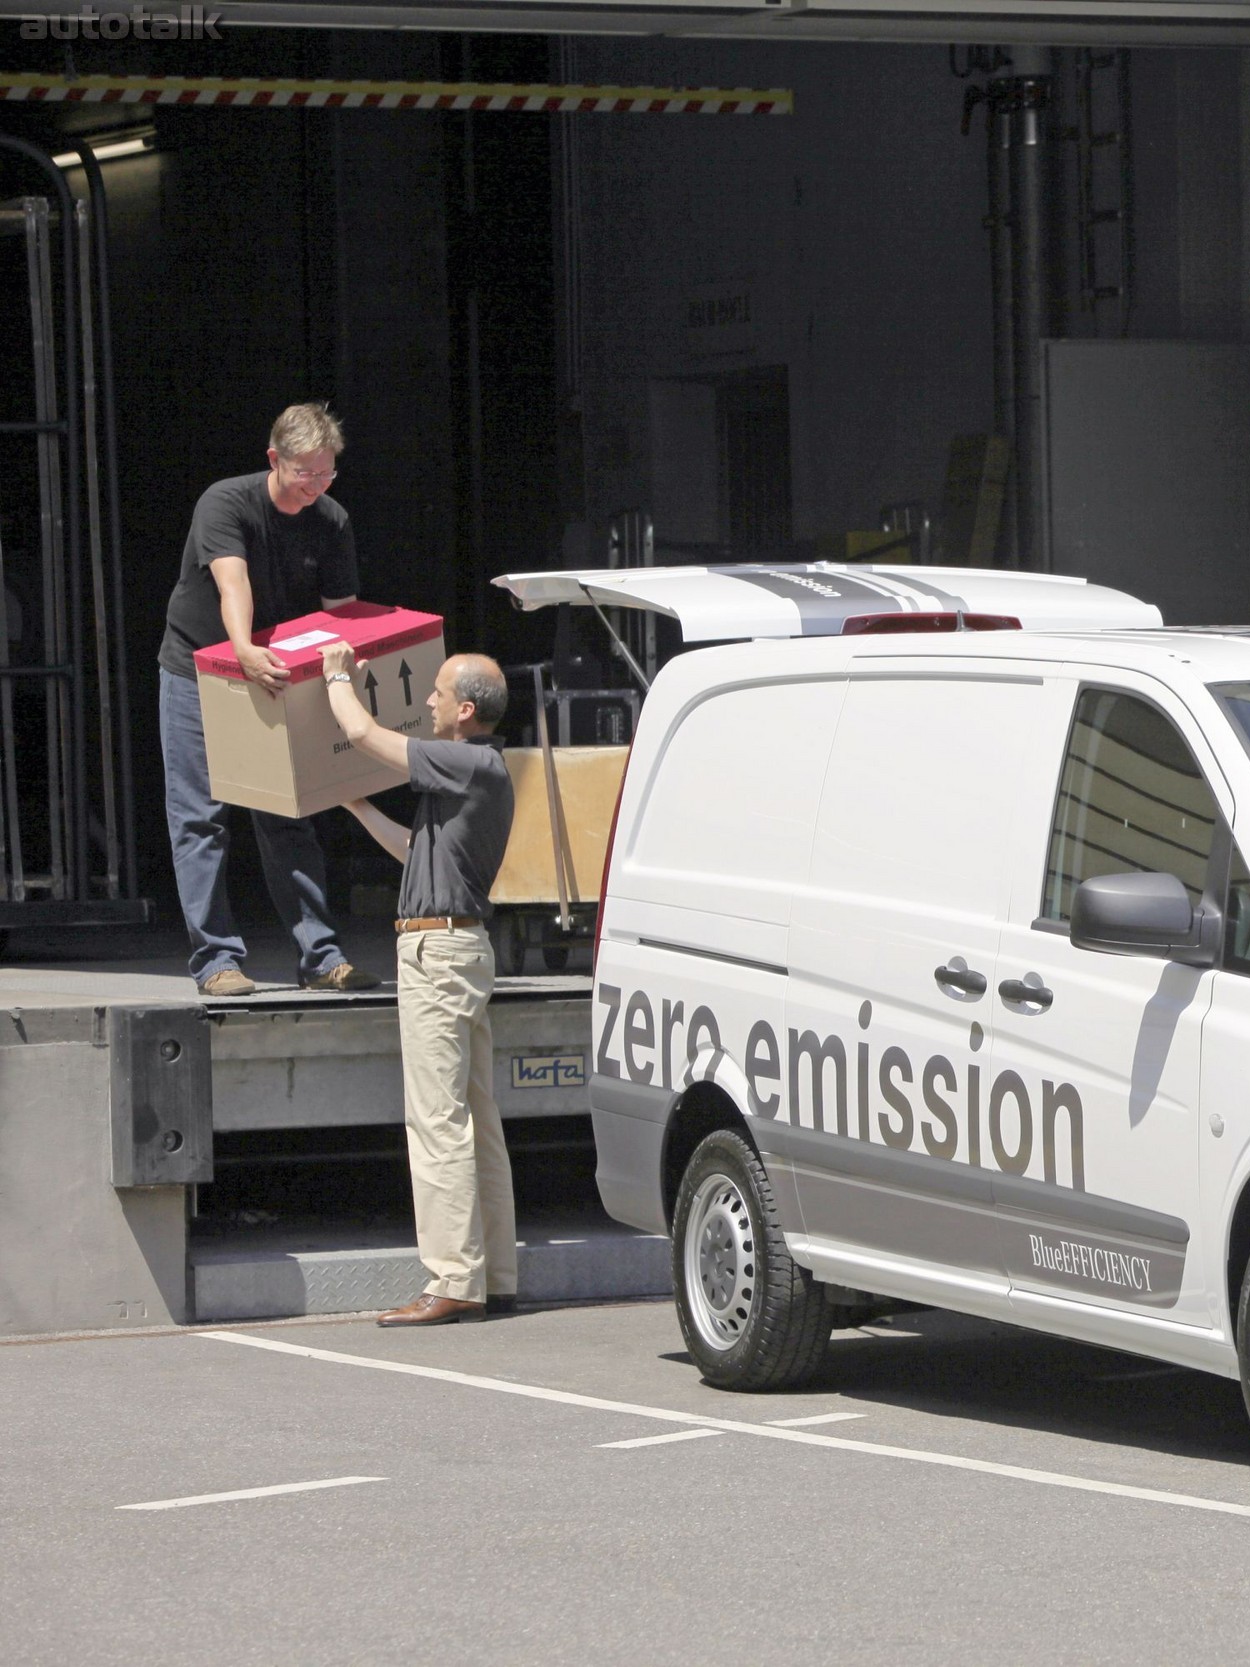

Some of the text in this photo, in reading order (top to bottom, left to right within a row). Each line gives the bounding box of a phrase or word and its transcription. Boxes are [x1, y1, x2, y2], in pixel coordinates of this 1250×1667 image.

[596, 982, 1086, 1193] zero emission
[1028, 1234, 1153, 1292] BlueEFFICIENCY
